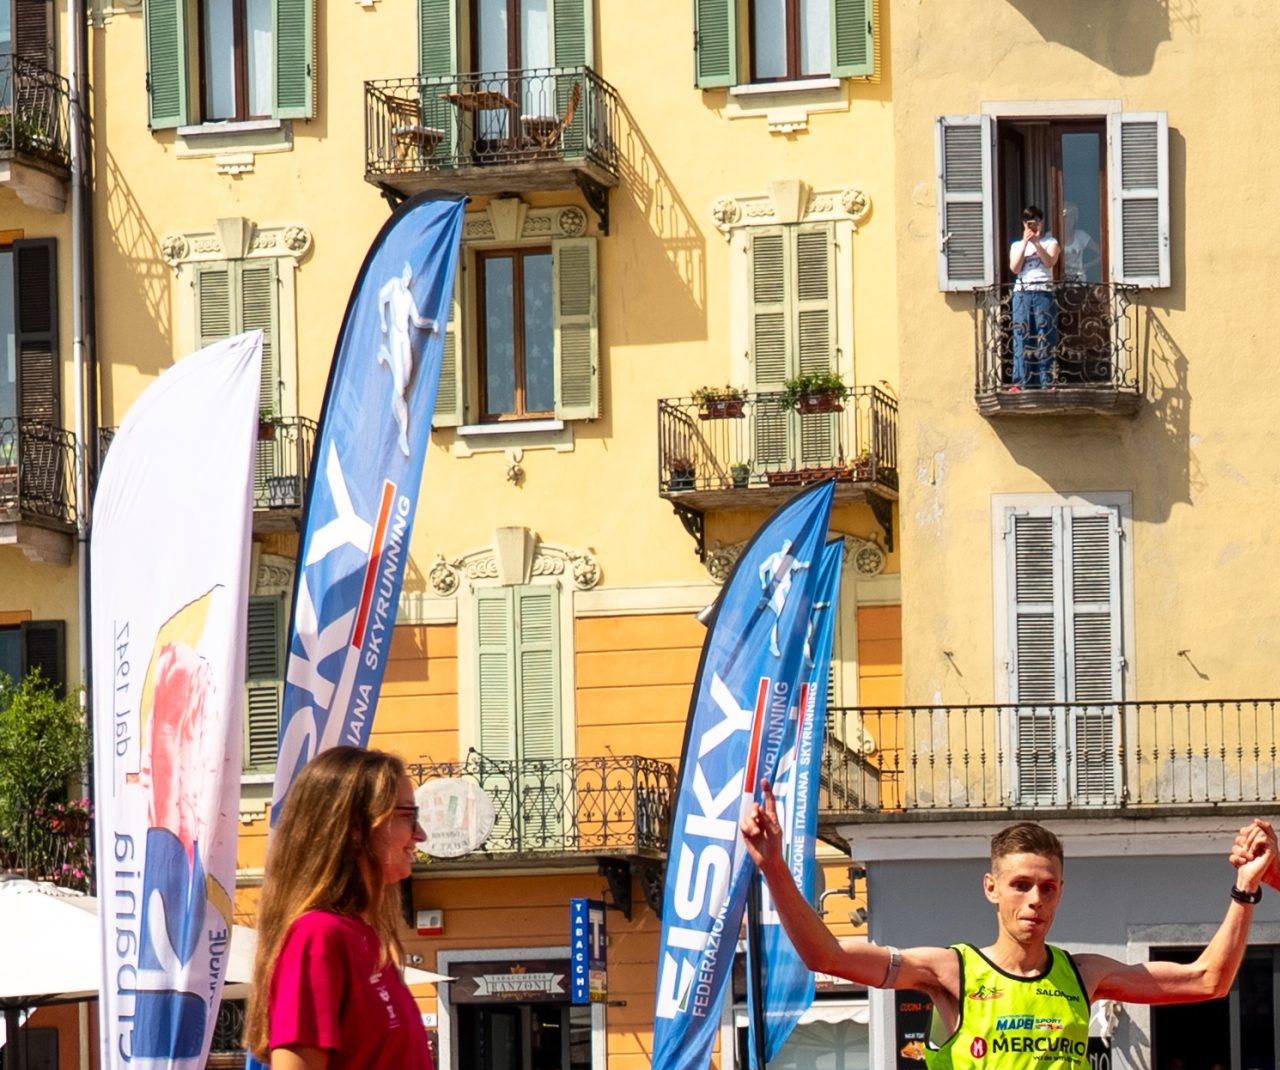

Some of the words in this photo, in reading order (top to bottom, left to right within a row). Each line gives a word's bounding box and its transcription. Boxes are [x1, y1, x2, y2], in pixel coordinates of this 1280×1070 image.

[364, 494, 412, 672] SKYRUNNING
[800, 681, 818, 766] SKYRUNNING
[793, 772, 810, 834] ITALIANA
[575, 903, 585, 999] TABACCHI
[1036, 988, 1080, 1003] SALOMON
[991, 1037, 1088, 1057] MERCURIO
